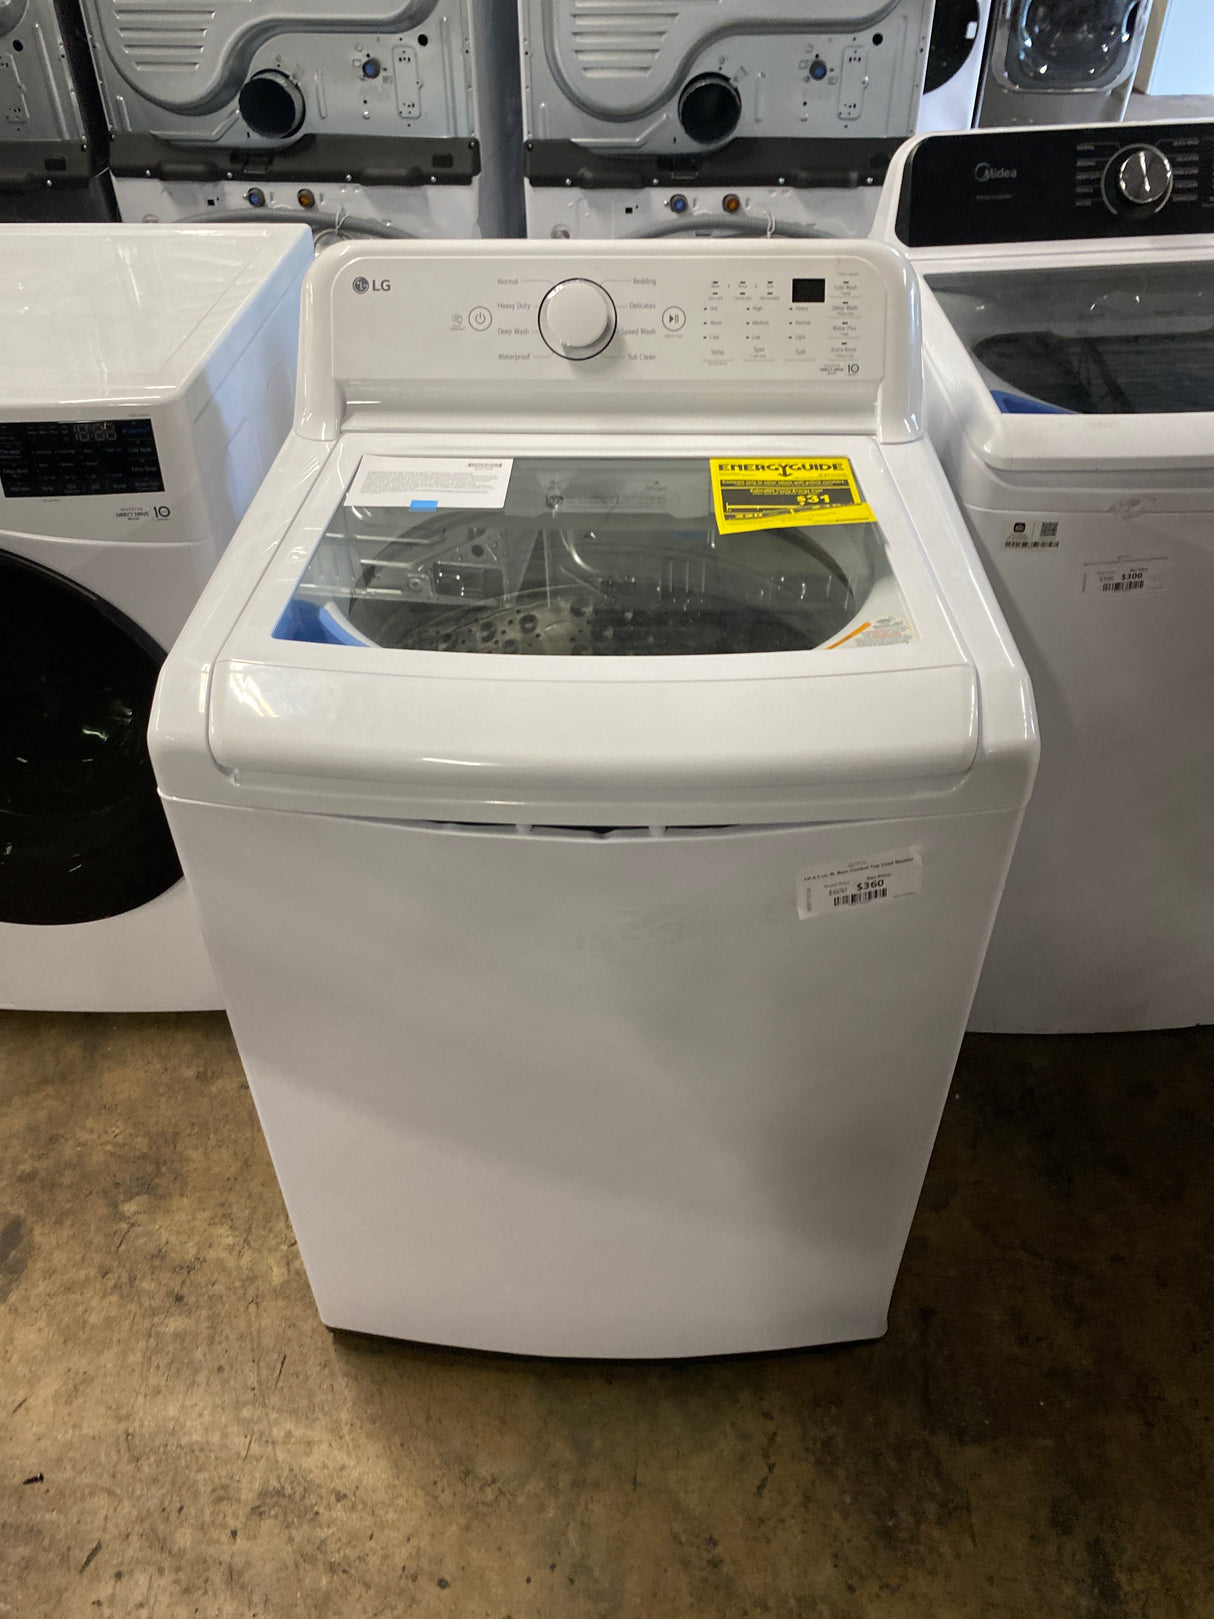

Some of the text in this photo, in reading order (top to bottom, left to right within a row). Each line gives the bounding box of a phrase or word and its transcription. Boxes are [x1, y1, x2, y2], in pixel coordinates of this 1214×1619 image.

[975, 162, 1017, 182] Midea
[372, 279, 391, 292] LG
[498, 277, 518, 285] Normal
[633, 277, 656, 286] Bedding
[498, 302, 531, 311] Heavy Duty
[498, 327, 530, 336] Deep Wash
[621, 328, 639, 336] Speed
[499, 353, 531, 361] Waterproof
[797, 494, 830, 504] $31
[153, 505, 171, 518] 10
[1121, 572, 1143, 581] $300
[857, 879, 885, 891] $360
